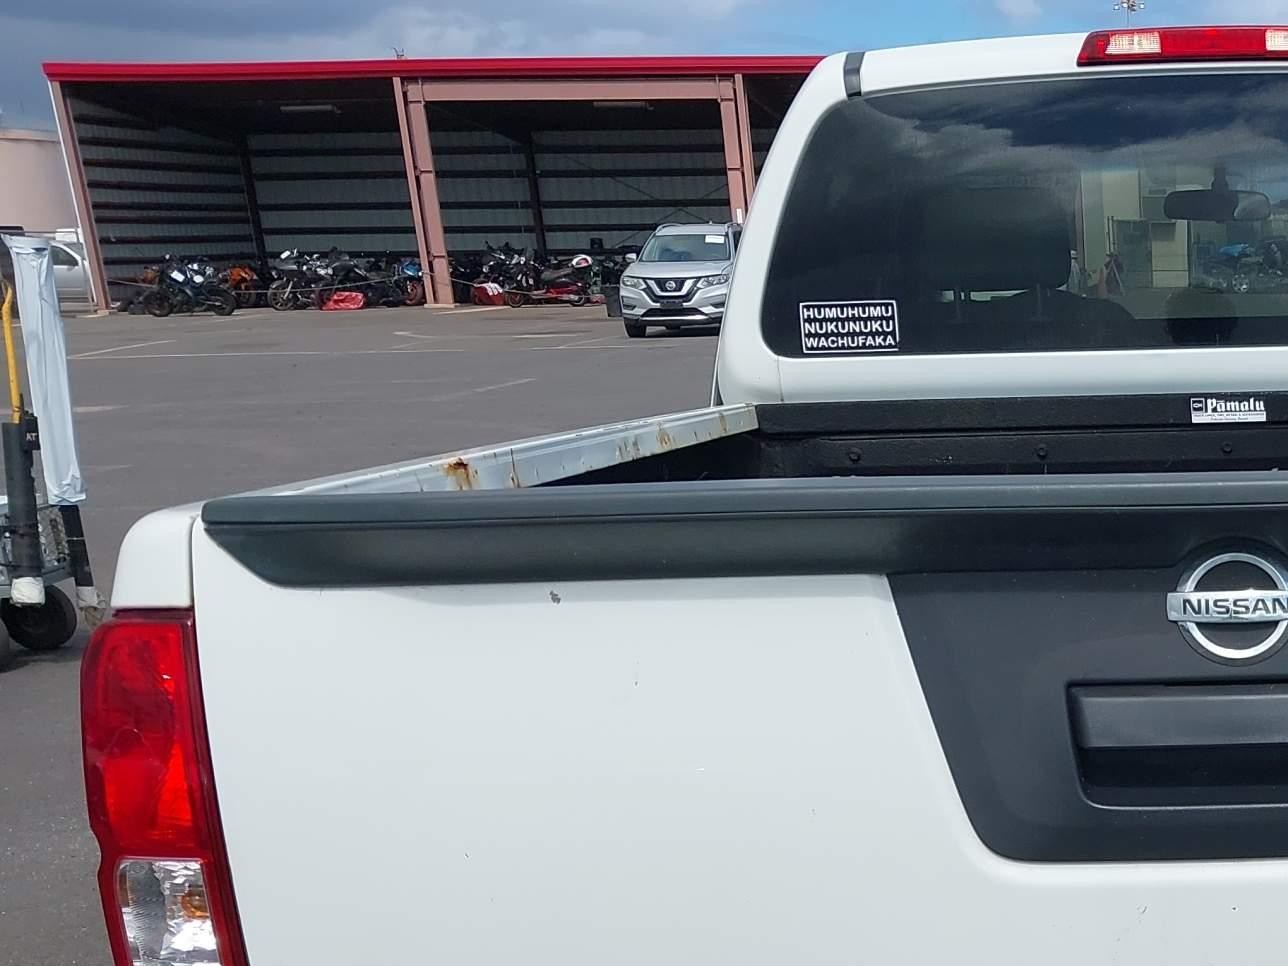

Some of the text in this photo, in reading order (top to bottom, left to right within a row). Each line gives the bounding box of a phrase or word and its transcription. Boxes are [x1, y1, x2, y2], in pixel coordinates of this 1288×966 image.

[803, 305, 893, 319] HUMUHUMU
[804, 320, 894, 334] NUKUNUKU
[805, 335, 895, 348] WACHUFAKA
